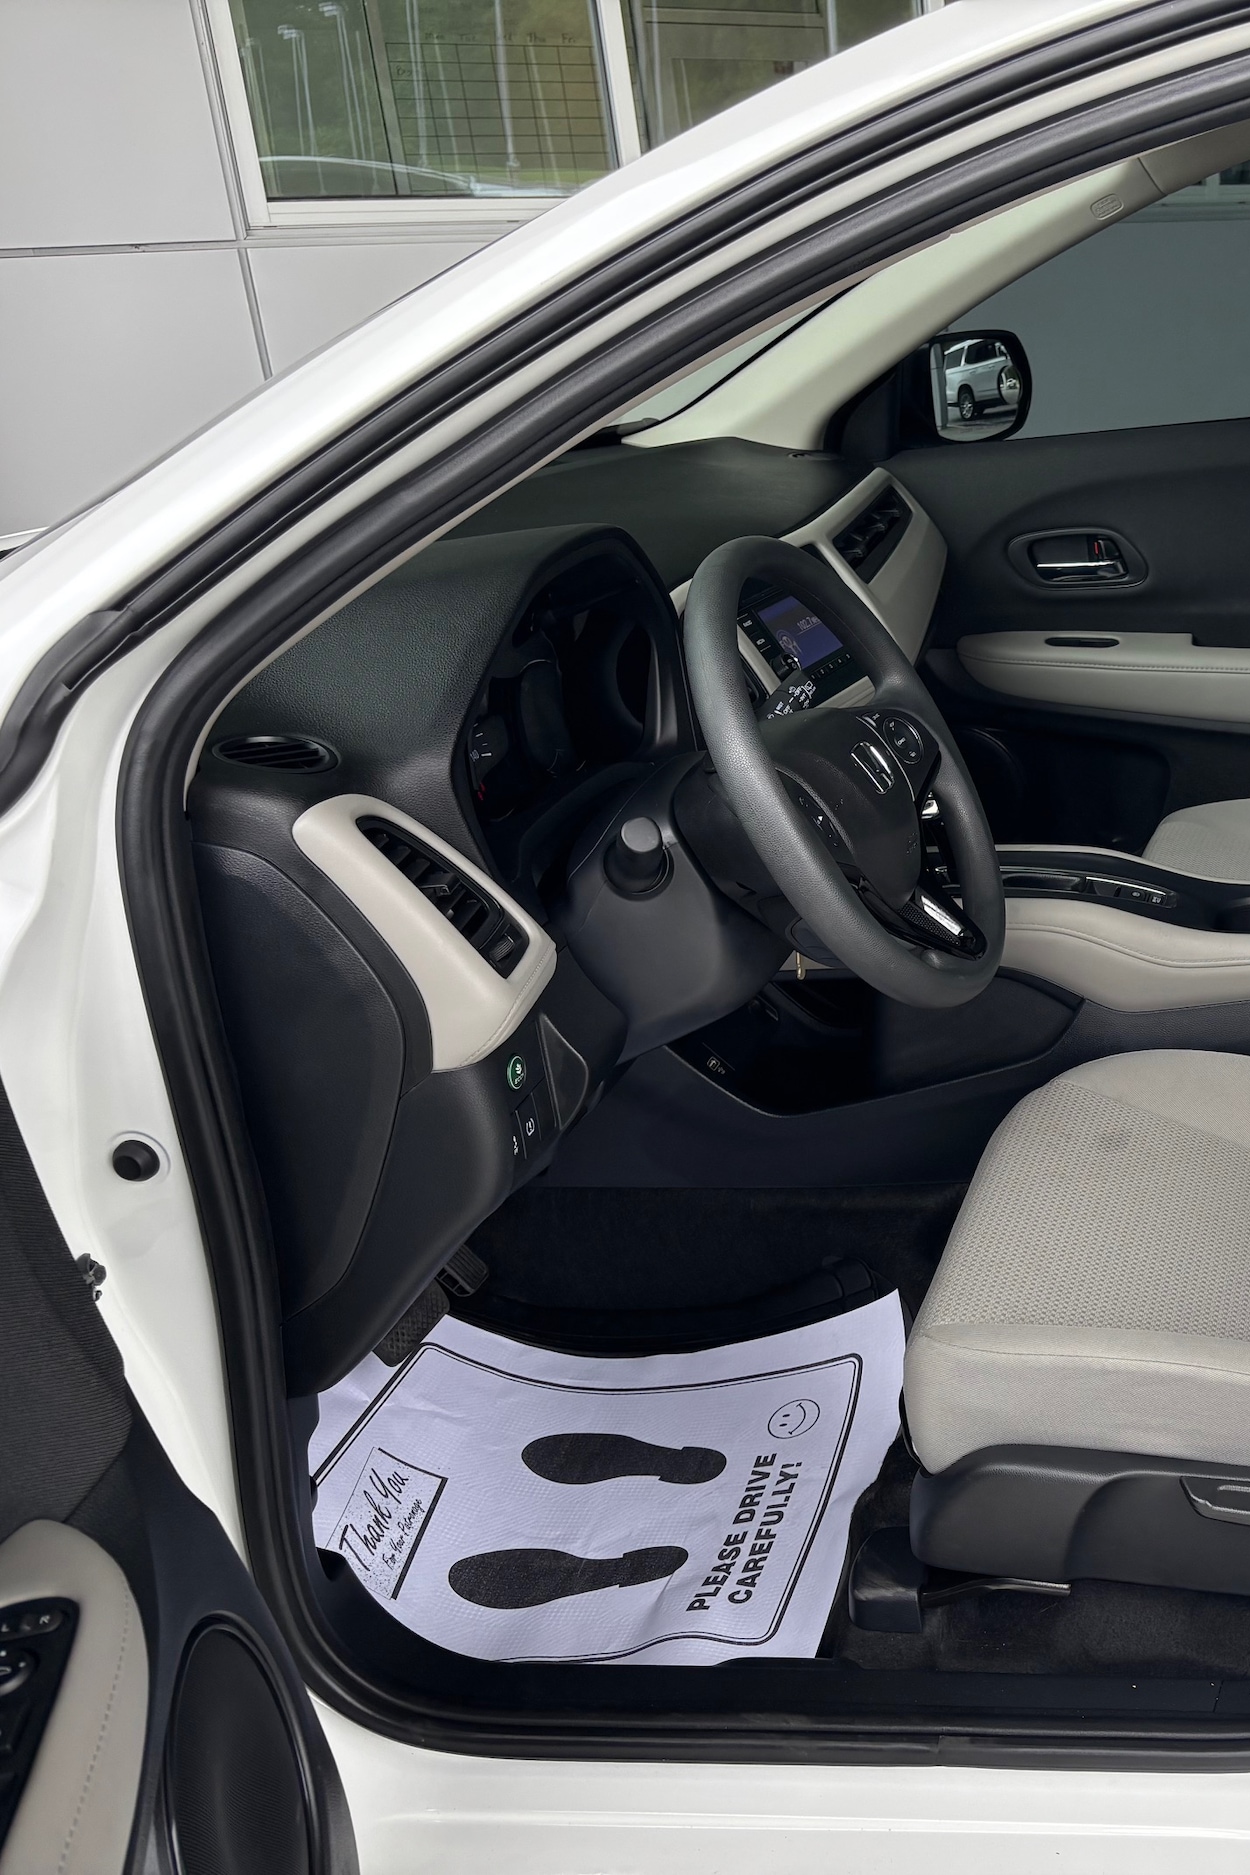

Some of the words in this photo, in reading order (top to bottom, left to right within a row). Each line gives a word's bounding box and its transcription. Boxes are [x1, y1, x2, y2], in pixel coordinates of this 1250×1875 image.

[338, 1490, 392, 1572] Thank
[369, 1468, 409, 1504] You
[389, 1536, 406, 1553] Your
[397, 1499, 426, 1536] Patronage
[686, 1531, 748, 1611] PLEASE
[733, 1453, 777, 1525] DRIVE
[728, 1462, 802, 1604] CAREFULLY!
